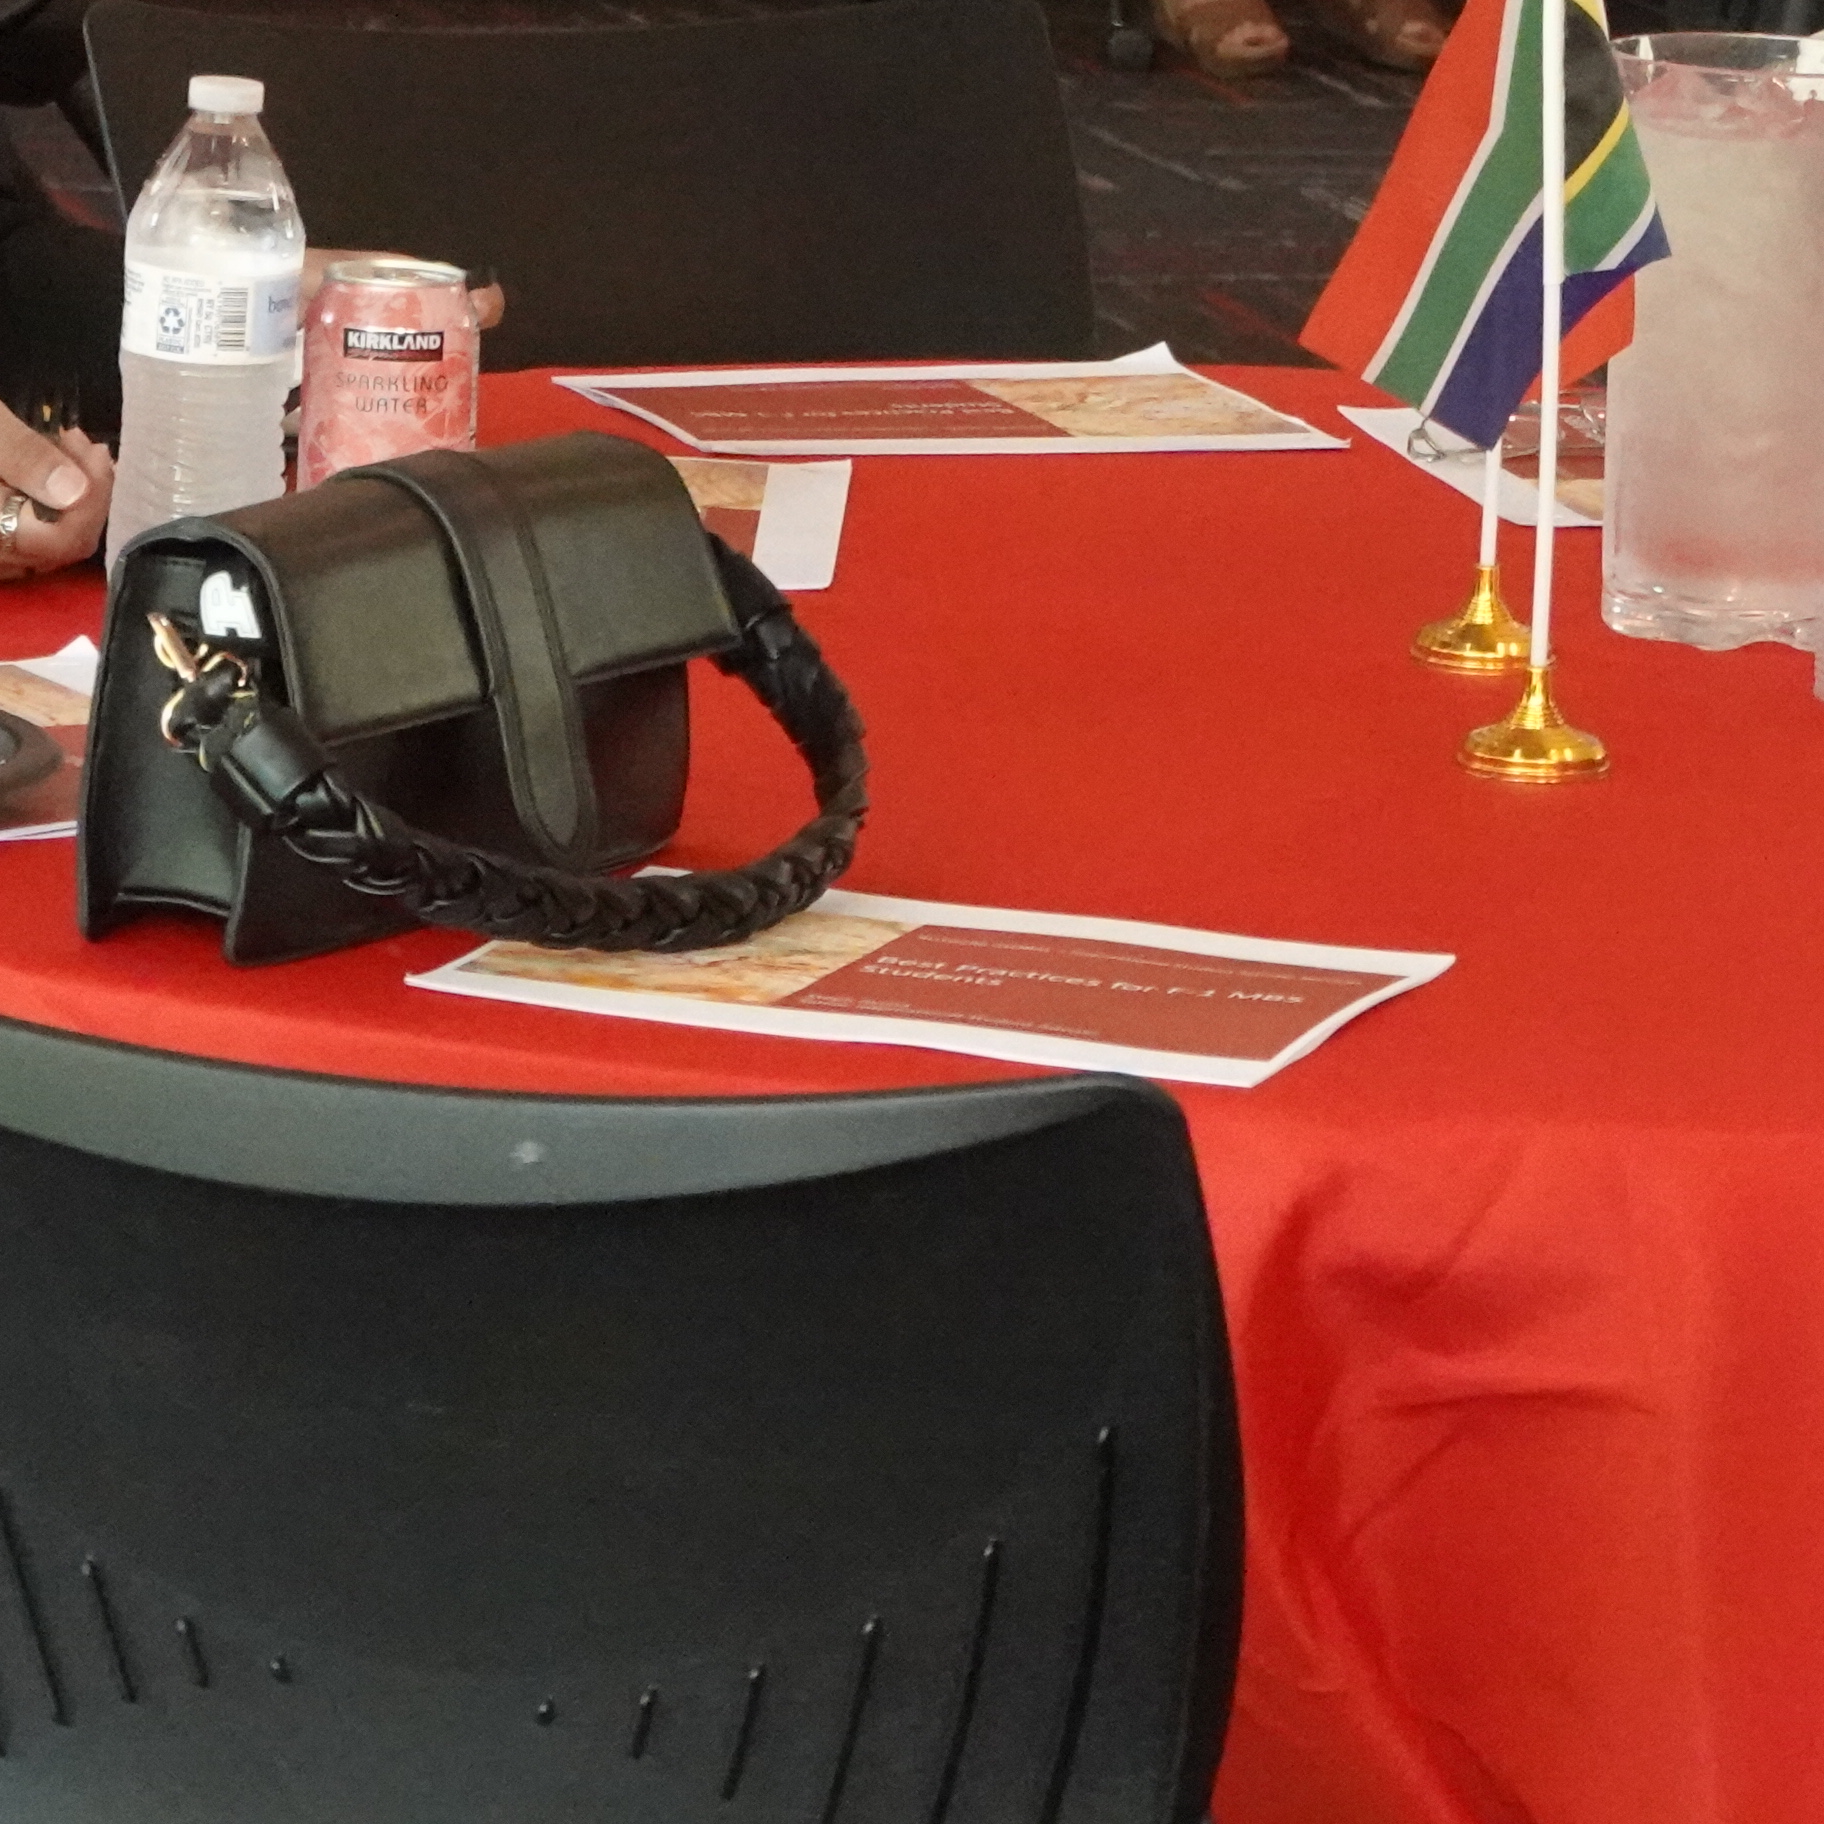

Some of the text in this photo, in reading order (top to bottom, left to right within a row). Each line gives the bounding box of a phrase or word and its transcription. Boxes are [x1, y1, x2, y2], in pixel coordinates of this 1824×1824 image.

[346, 331, 442, 351] KIRKLAND
[335, 372, 449, 392] SPARKLING
[355, 398, 428, 413] WATER
[859, 964, 1003, 987] Students
[876, 955, 949, 970] Best
[955, 964, 1103, 987] Practices
[1111, 981, 1159, 993] for
